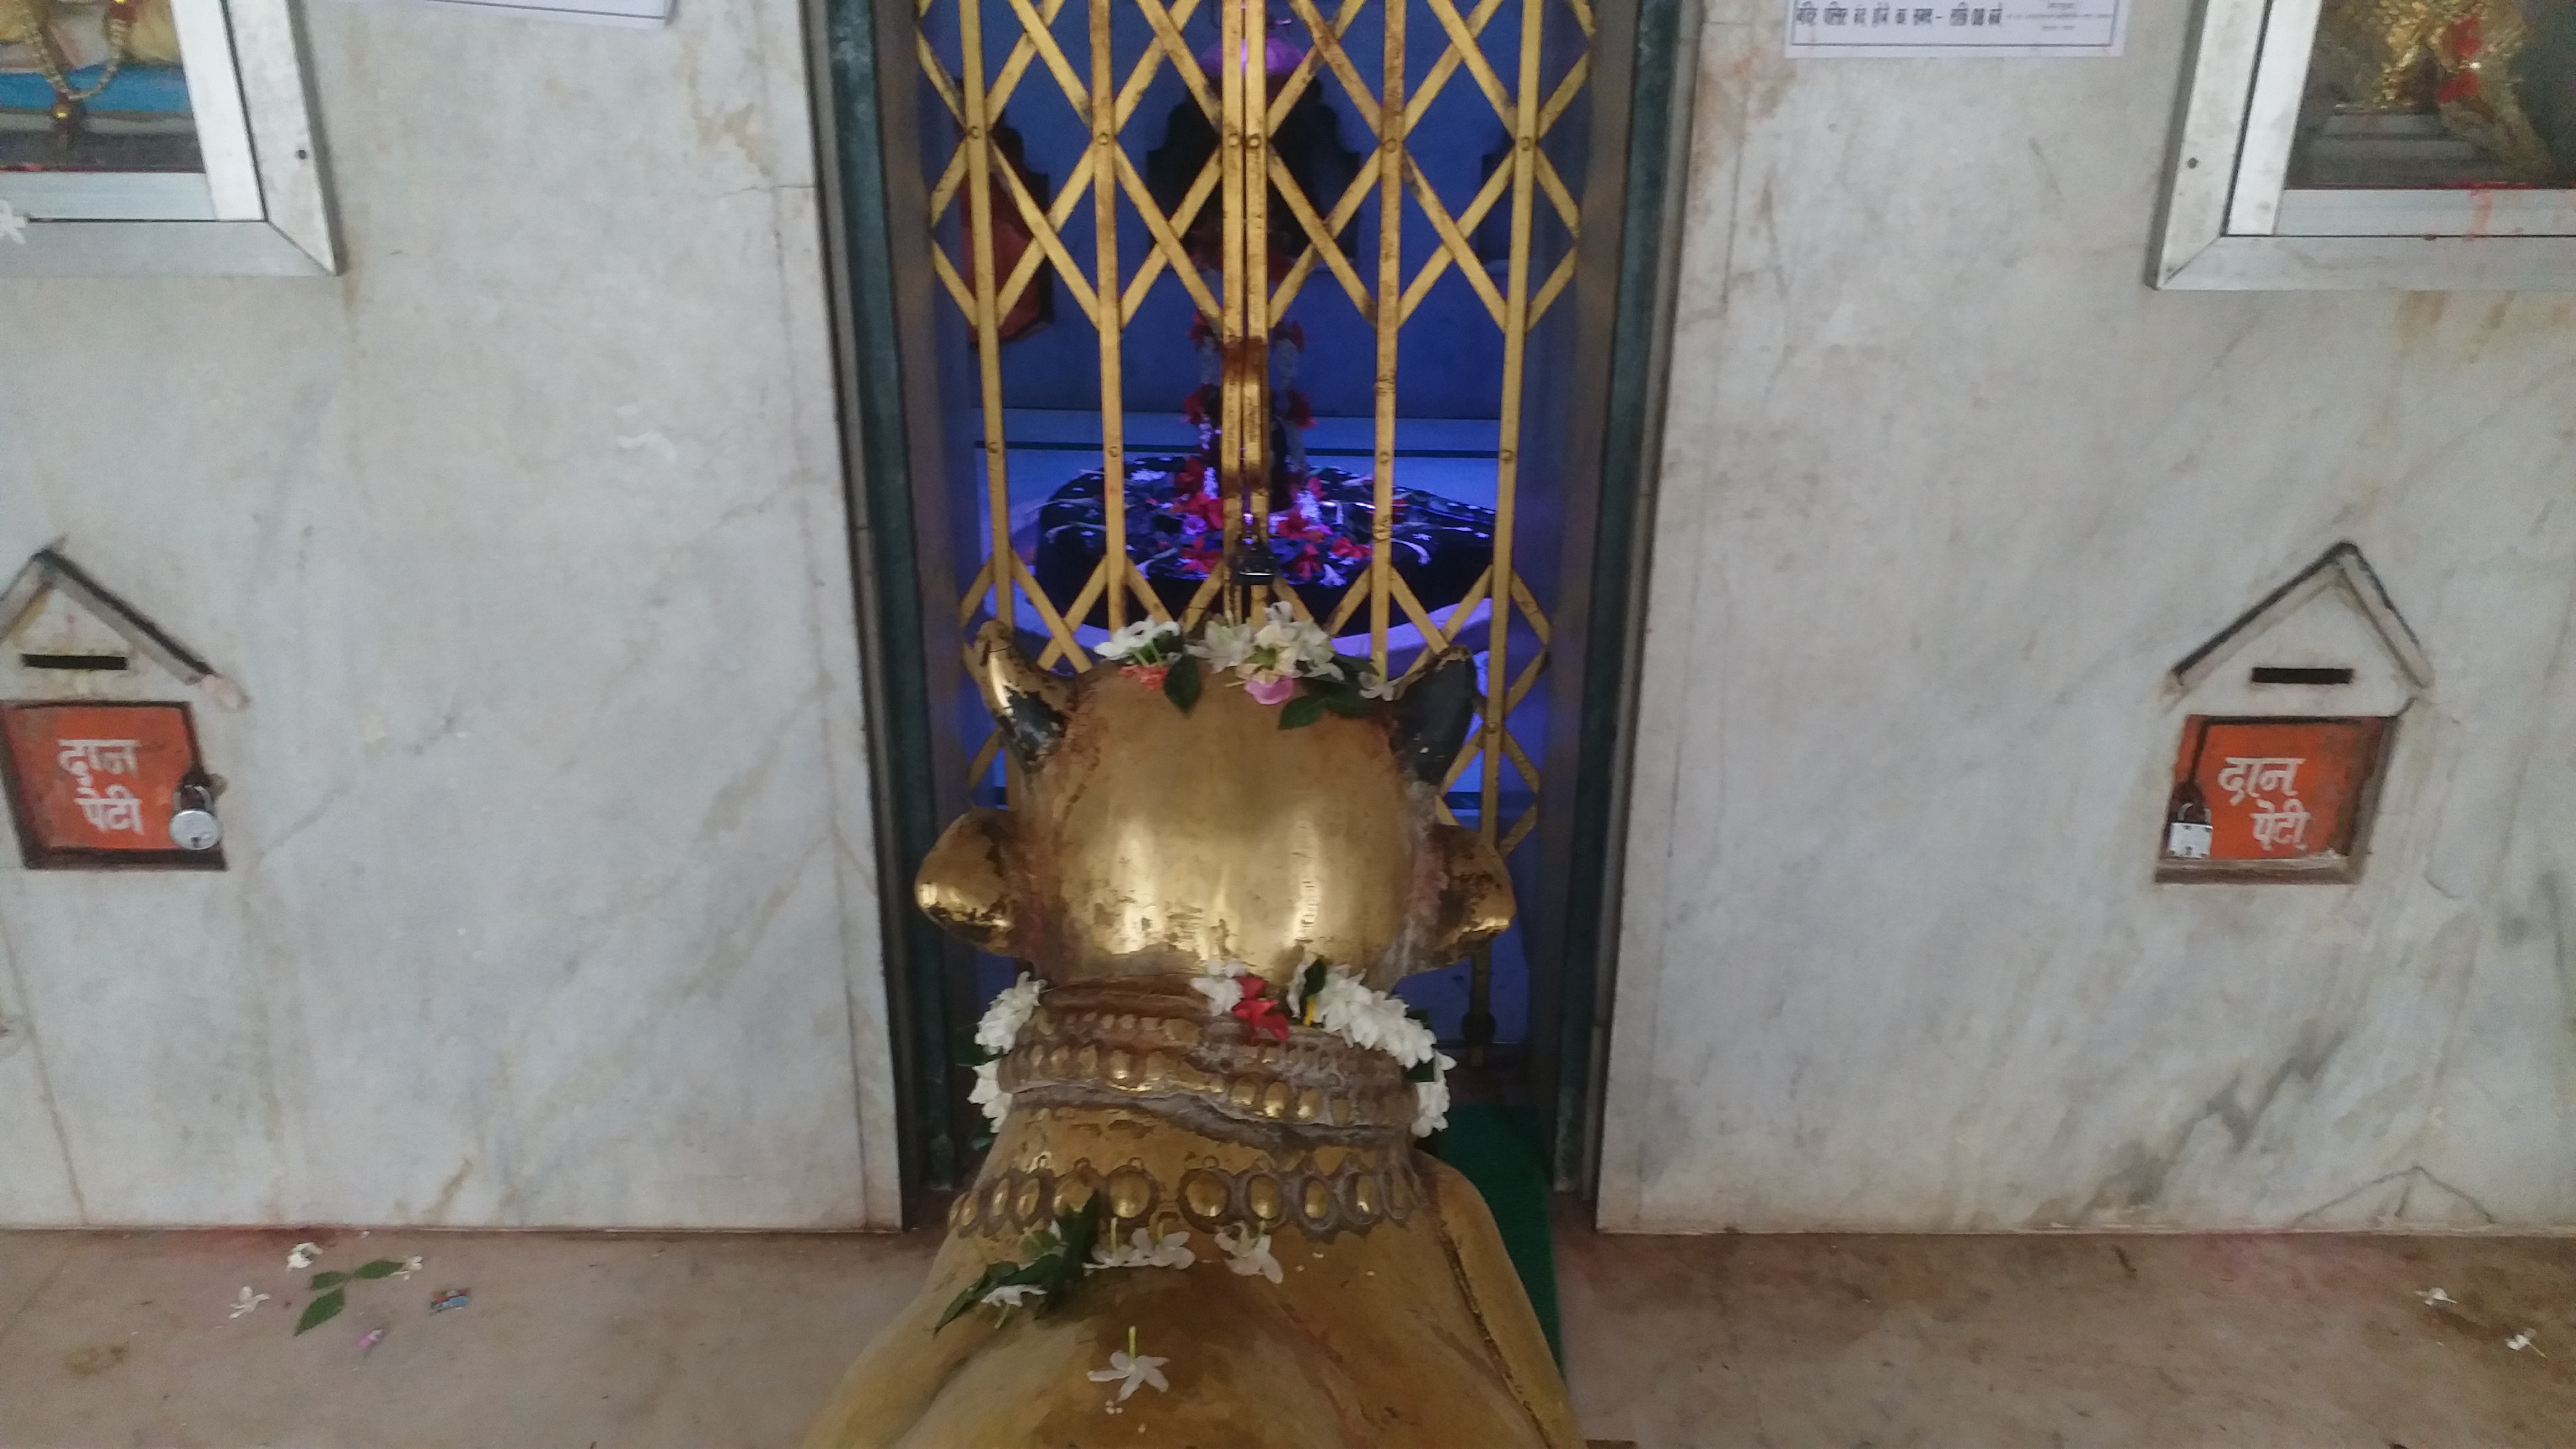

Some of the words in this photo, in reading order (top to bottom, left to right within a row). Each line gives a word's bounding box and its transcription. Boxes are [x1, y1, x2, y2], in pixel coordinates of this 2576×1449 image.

[58, 740, 140, 787] दान
[2218, 757, 2306, 806] दान
[74, 785, 143, 835] पेटी
[2250, 798, 2310, 850] पेटी
